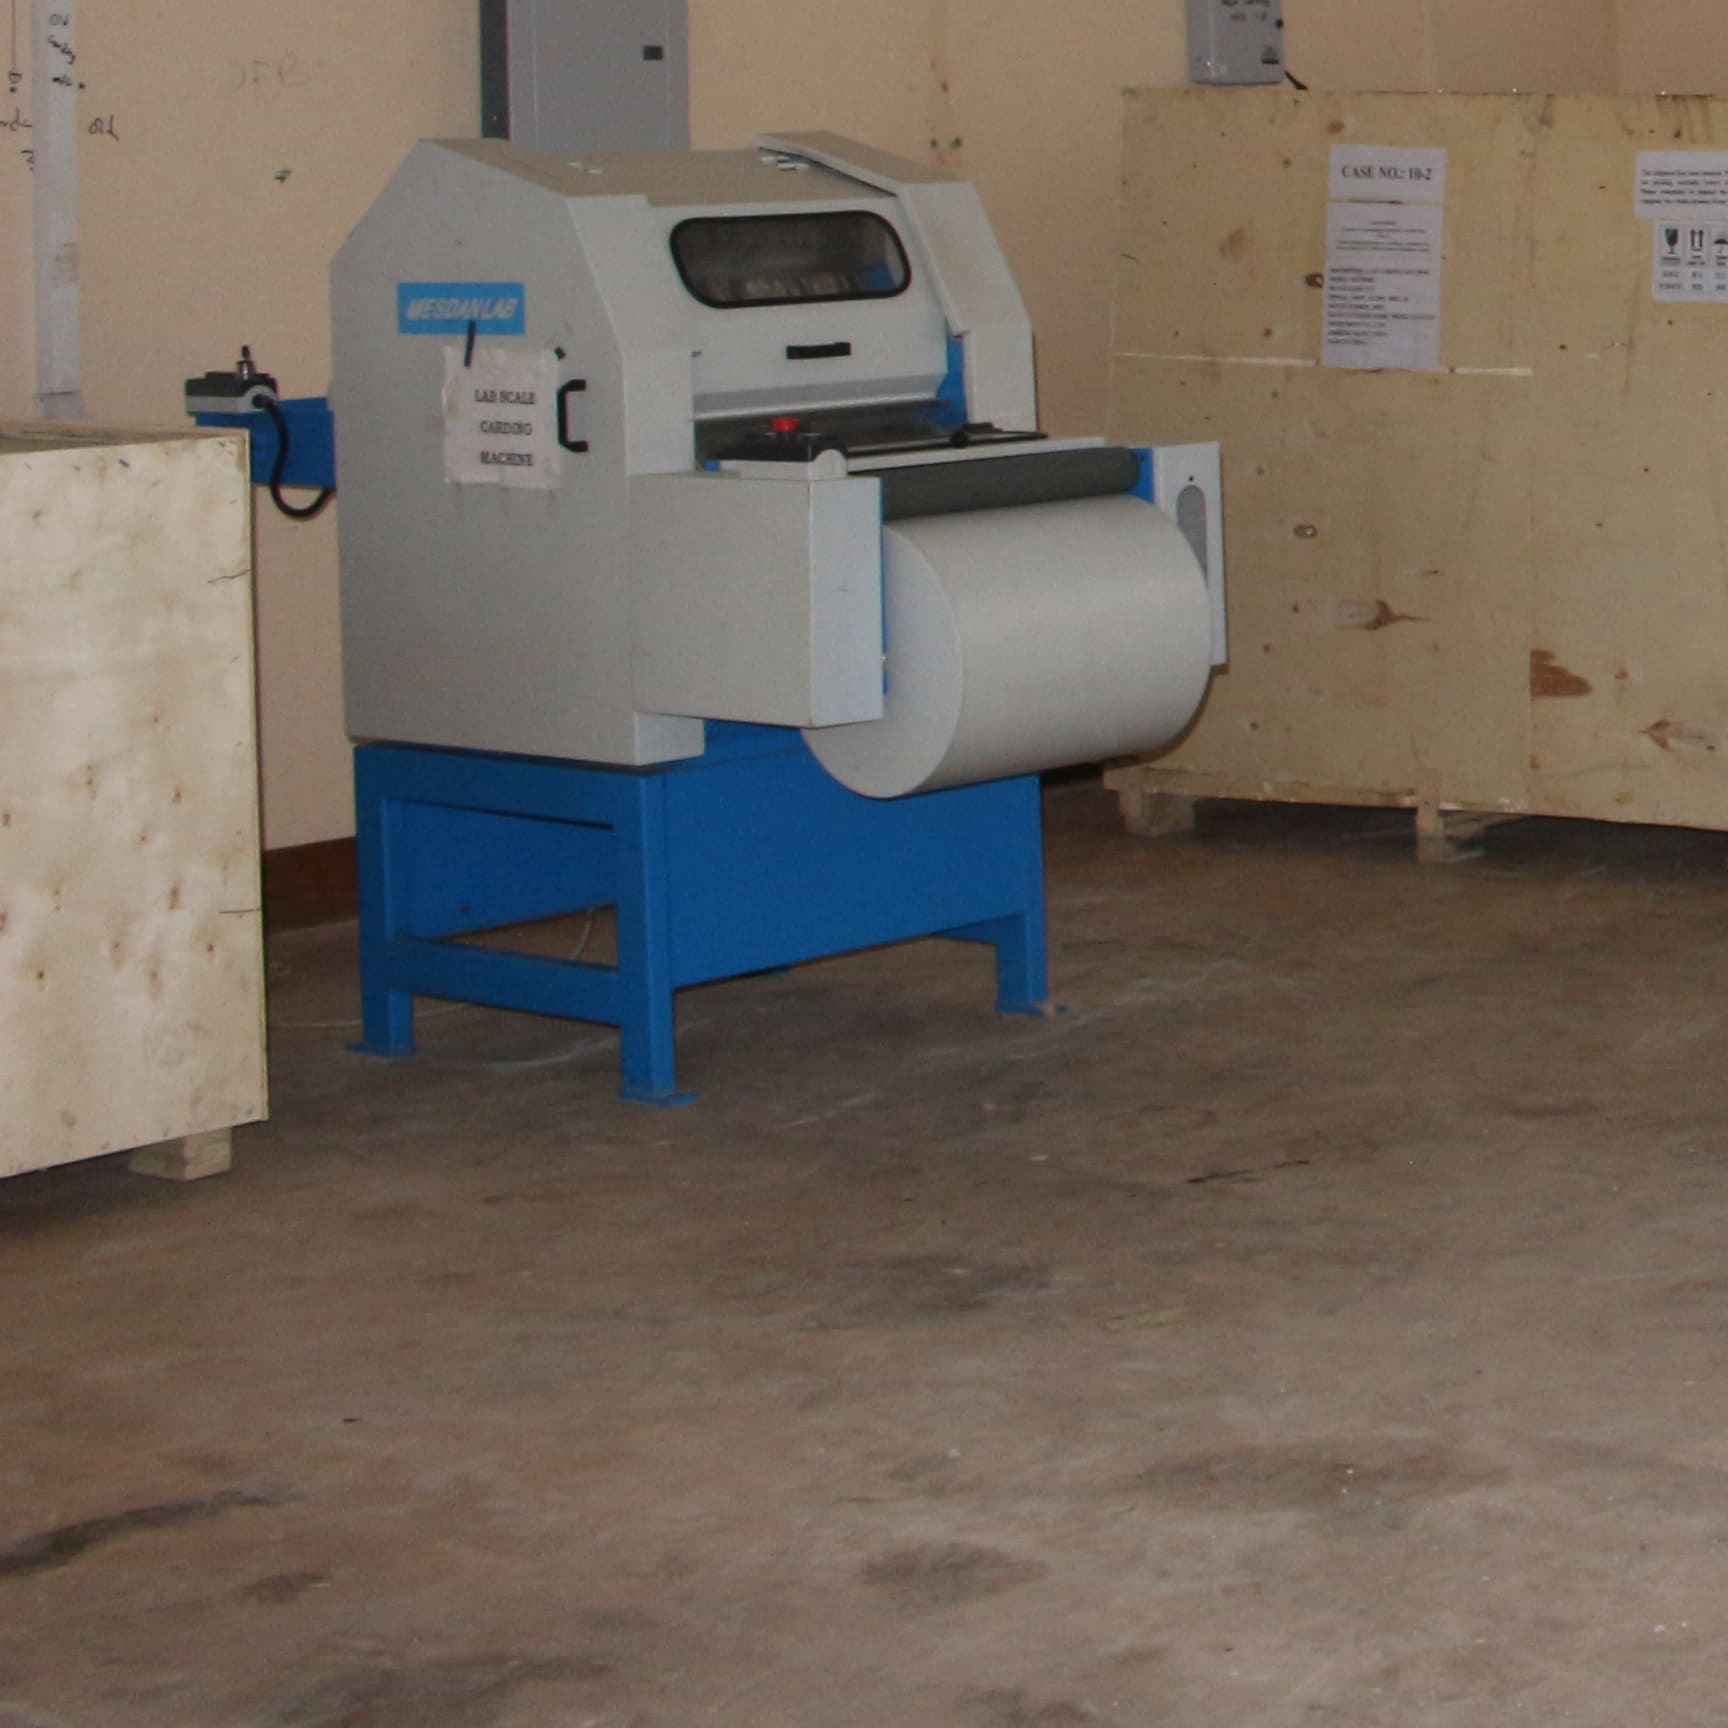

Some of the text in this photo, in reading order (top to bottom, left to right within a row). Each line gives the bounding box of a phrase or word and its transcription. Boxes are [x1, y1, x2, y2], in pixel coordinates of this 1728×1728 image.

[1341, 165, 1376, 180] CASE
[474, 390, 536, 405] LAB SCALE
[480, 421, 532, 435] CARDING
[480, 451, 534, 466] MACHINE
